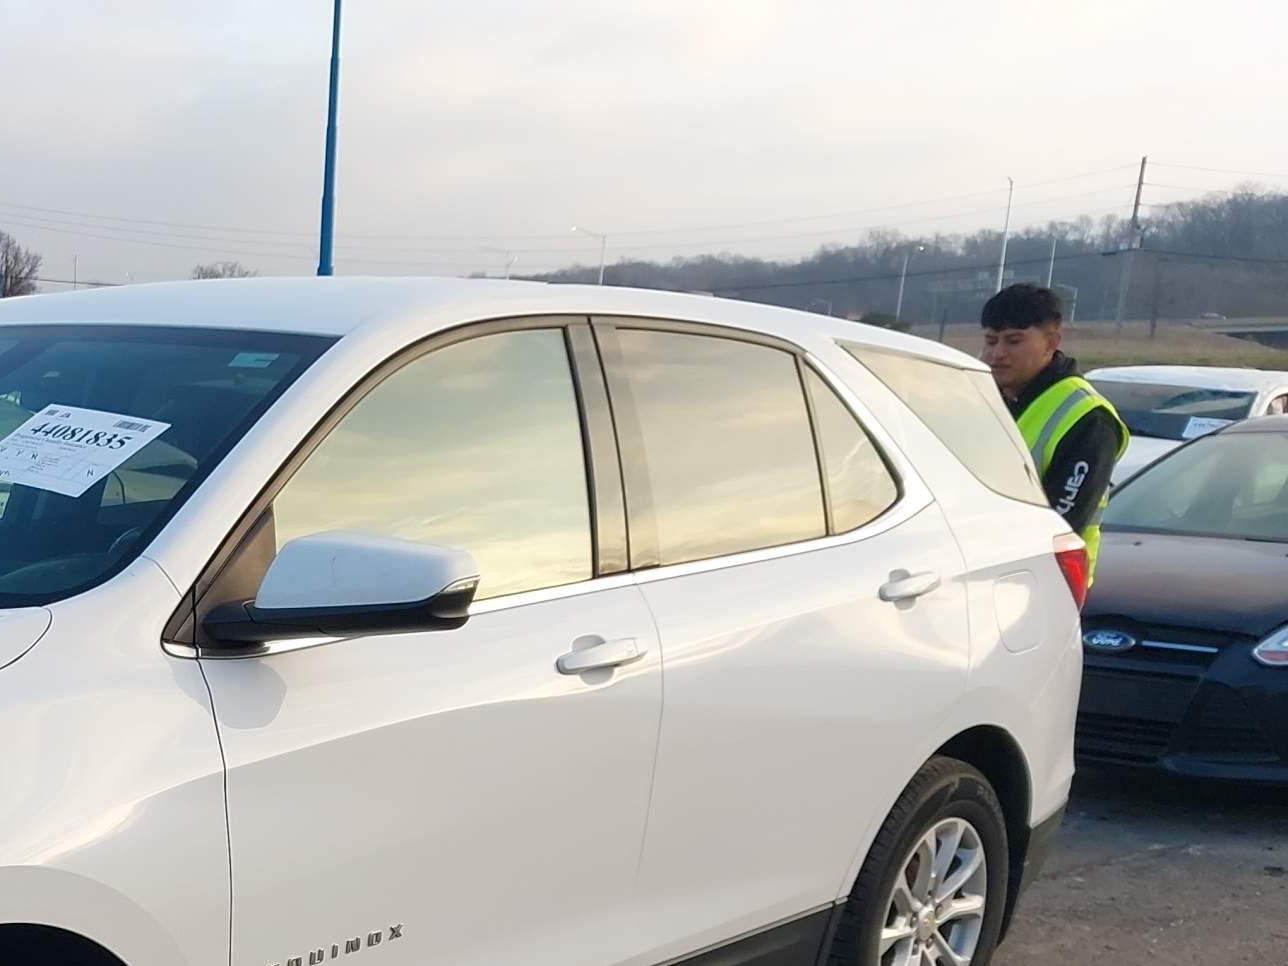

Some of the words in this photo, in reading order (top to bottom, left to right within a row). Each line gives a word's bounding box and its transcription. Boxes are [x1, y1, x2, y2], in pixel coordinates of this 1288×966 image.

[29, 421, 135, 450] 44081835
[1056, 461, 1089, 516] carh
[1091, 631, 1123, 647] Ford
